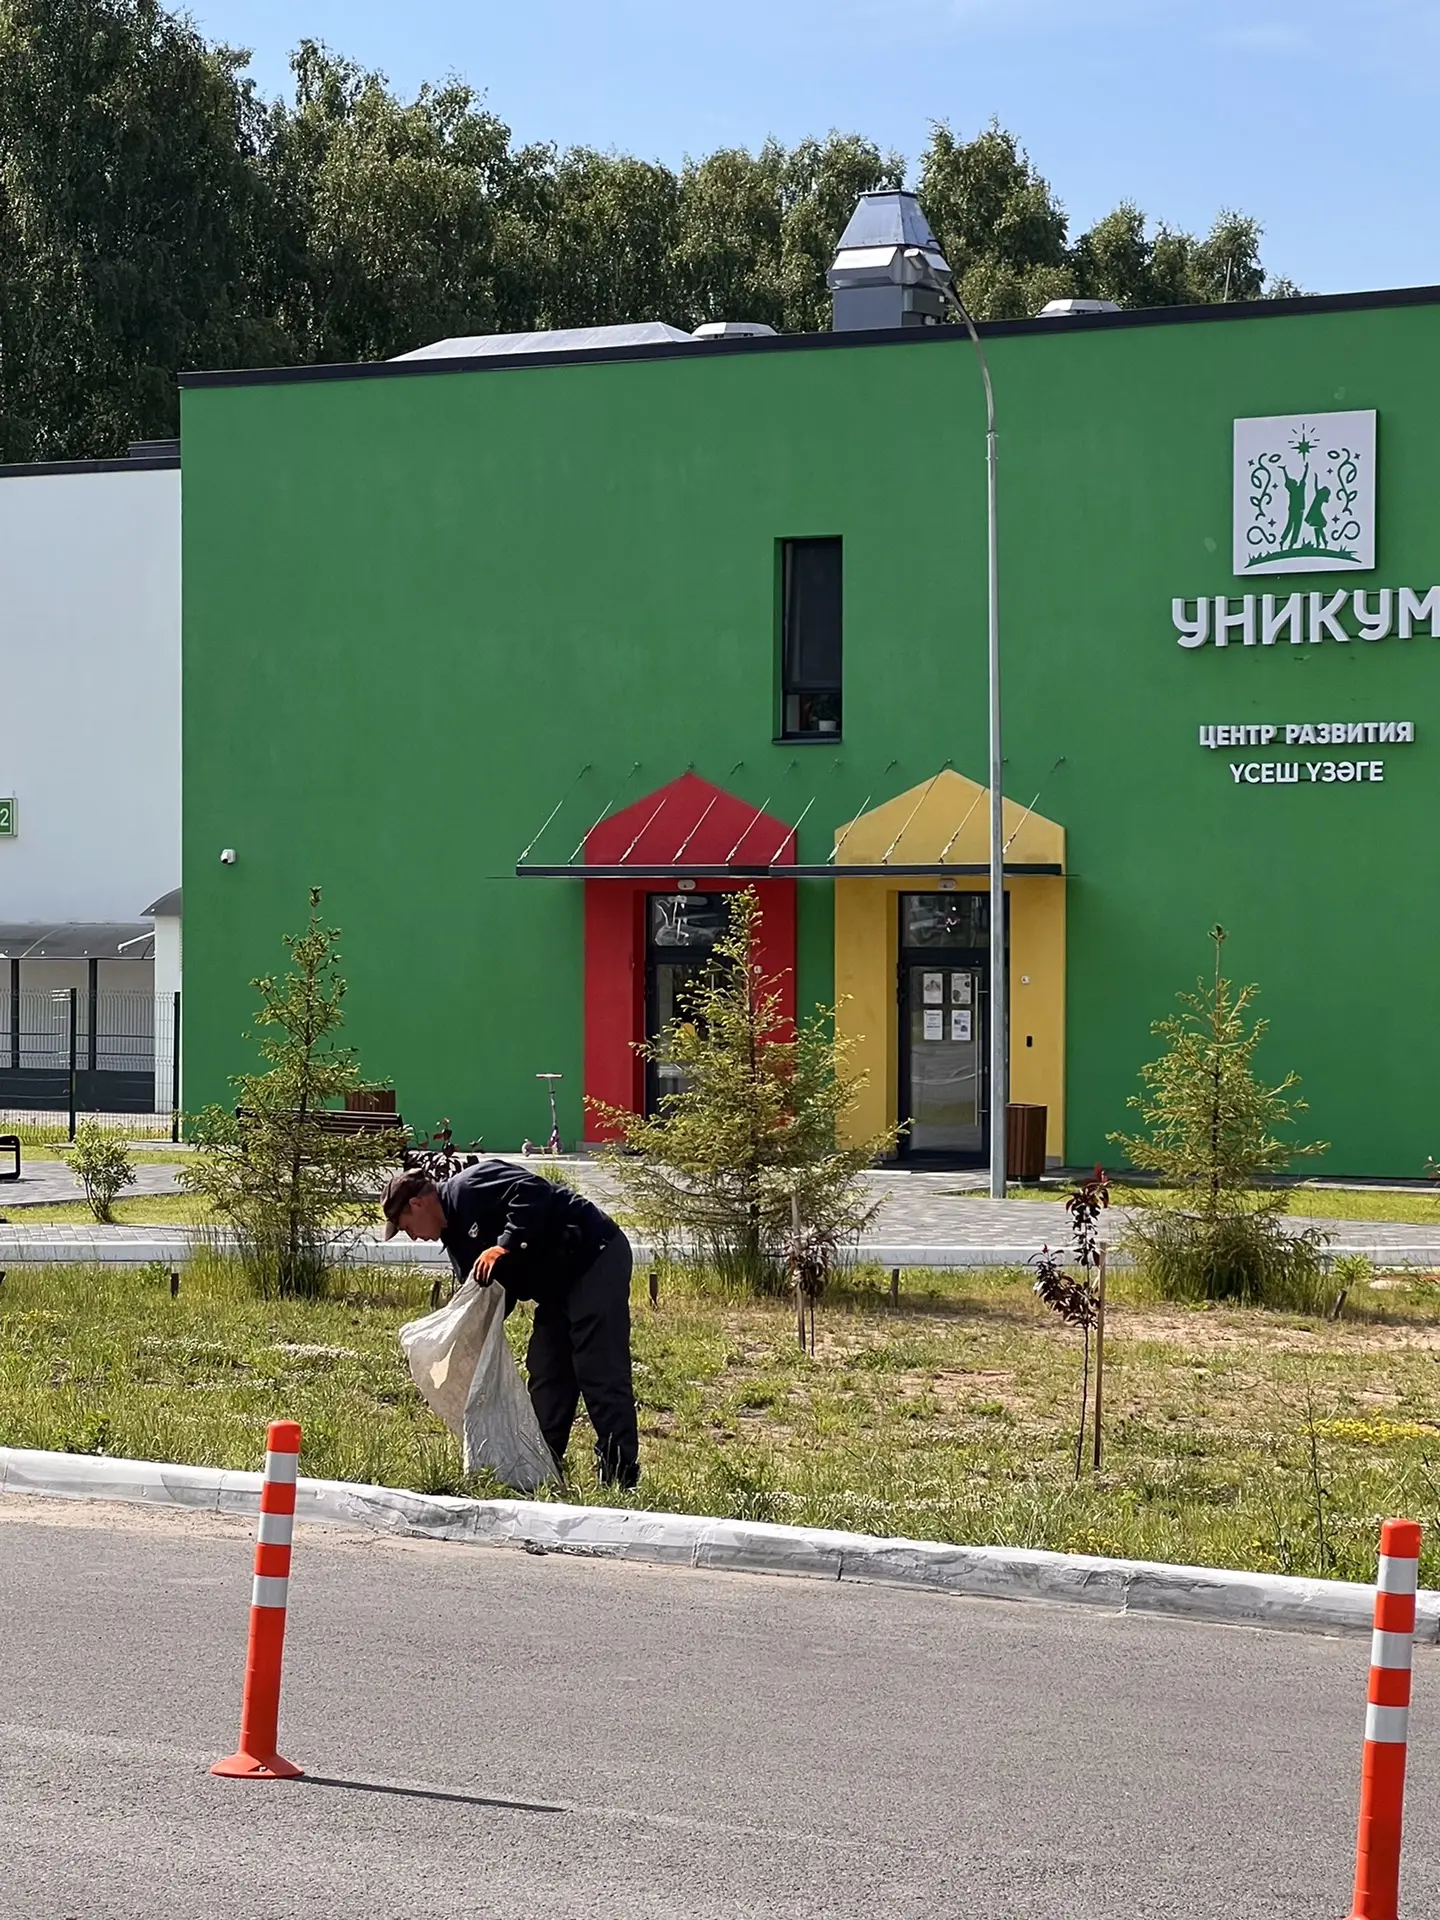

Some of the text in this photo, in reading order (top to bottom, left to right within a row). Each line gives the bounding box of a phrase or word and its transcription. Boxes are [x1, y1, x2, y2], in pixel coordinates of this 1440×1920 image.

[1171, 586, 1440, 648] УНИКУМ
[1200, 721, 1414, 748] ЦЕНТР РАЗВИТИЯ
[1229, 763, 1299, 783] ҮСЕШ
